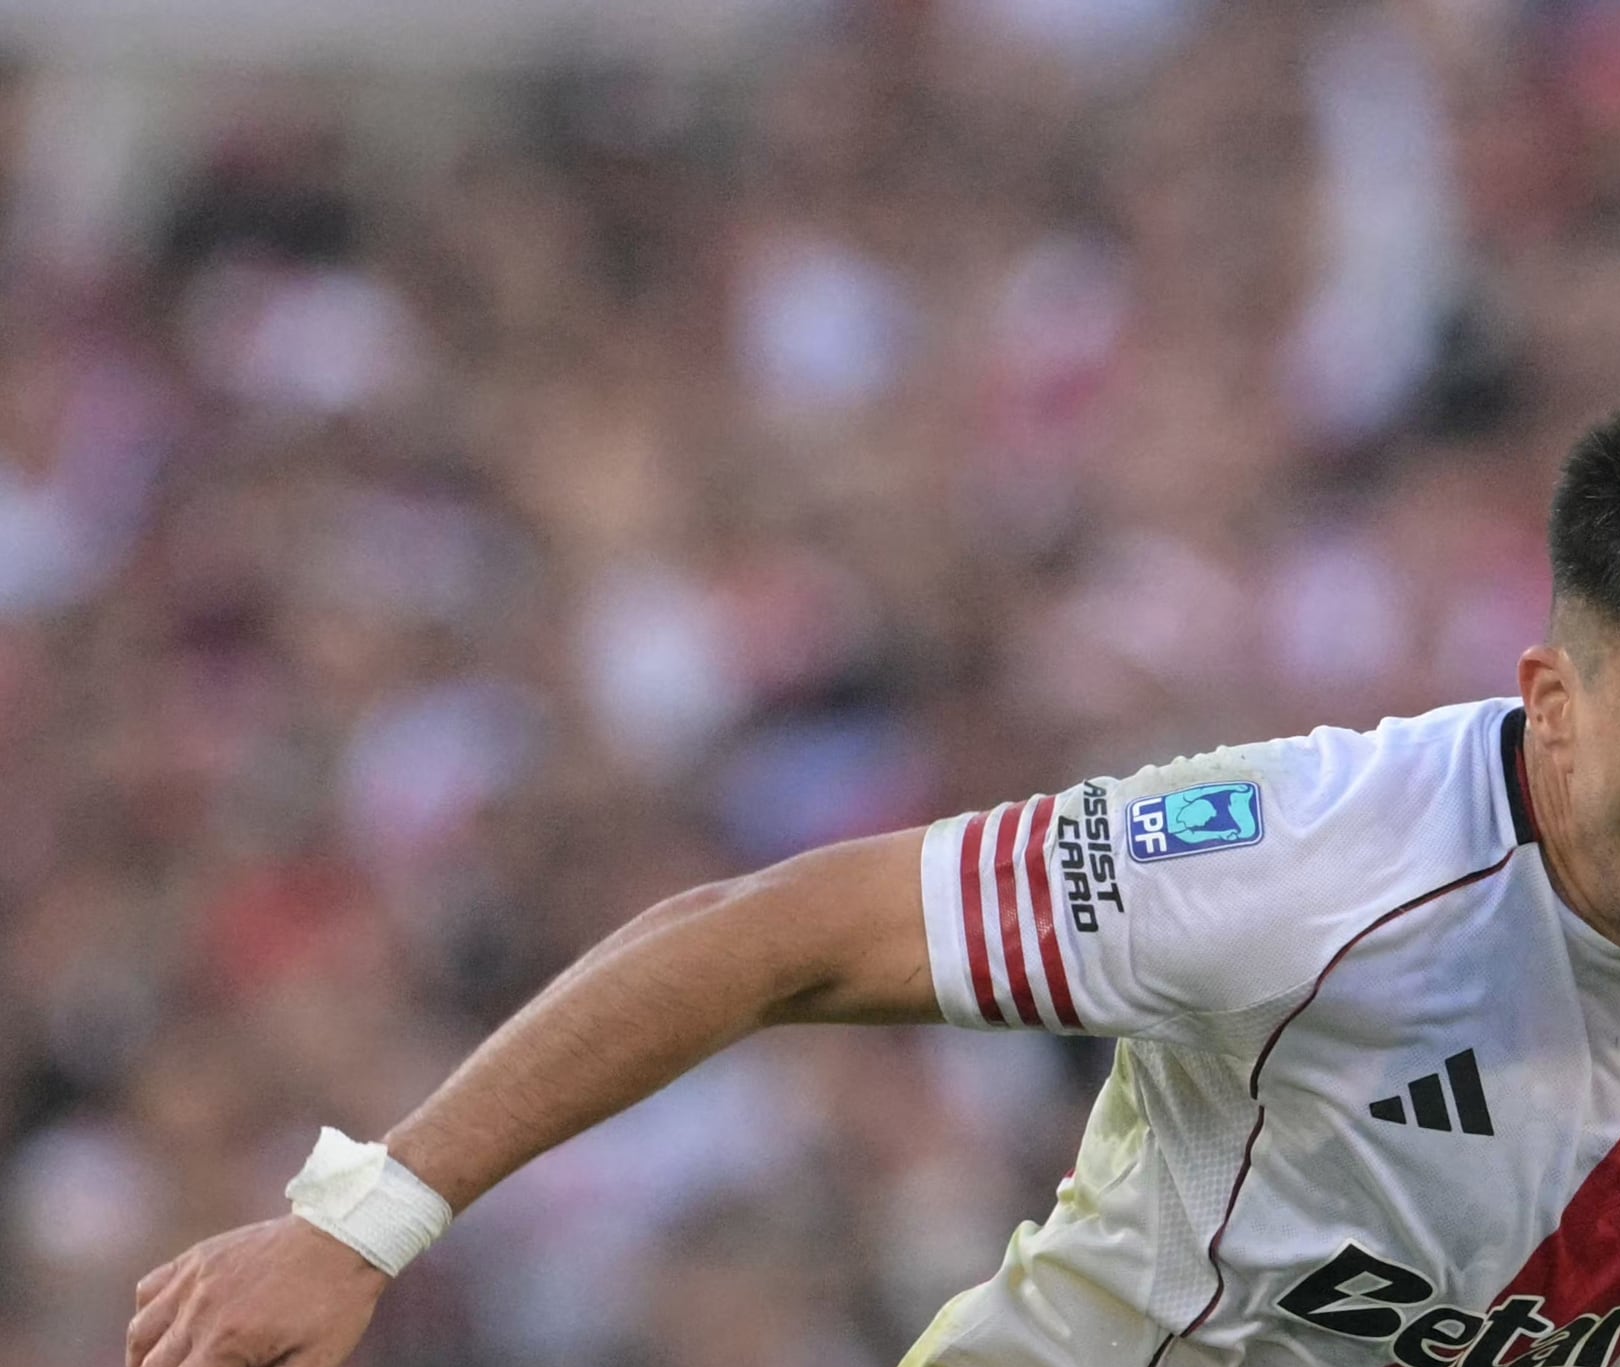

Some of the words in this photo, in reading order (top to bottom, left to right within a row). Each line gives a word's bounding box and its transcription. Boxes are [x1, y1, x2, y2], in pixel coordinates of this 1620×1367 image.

[1058, 815, 1099, 933] CARD
[1084, 780, 1125, 913] ASSIST
[1132, 798, 1168, 854] LPF
